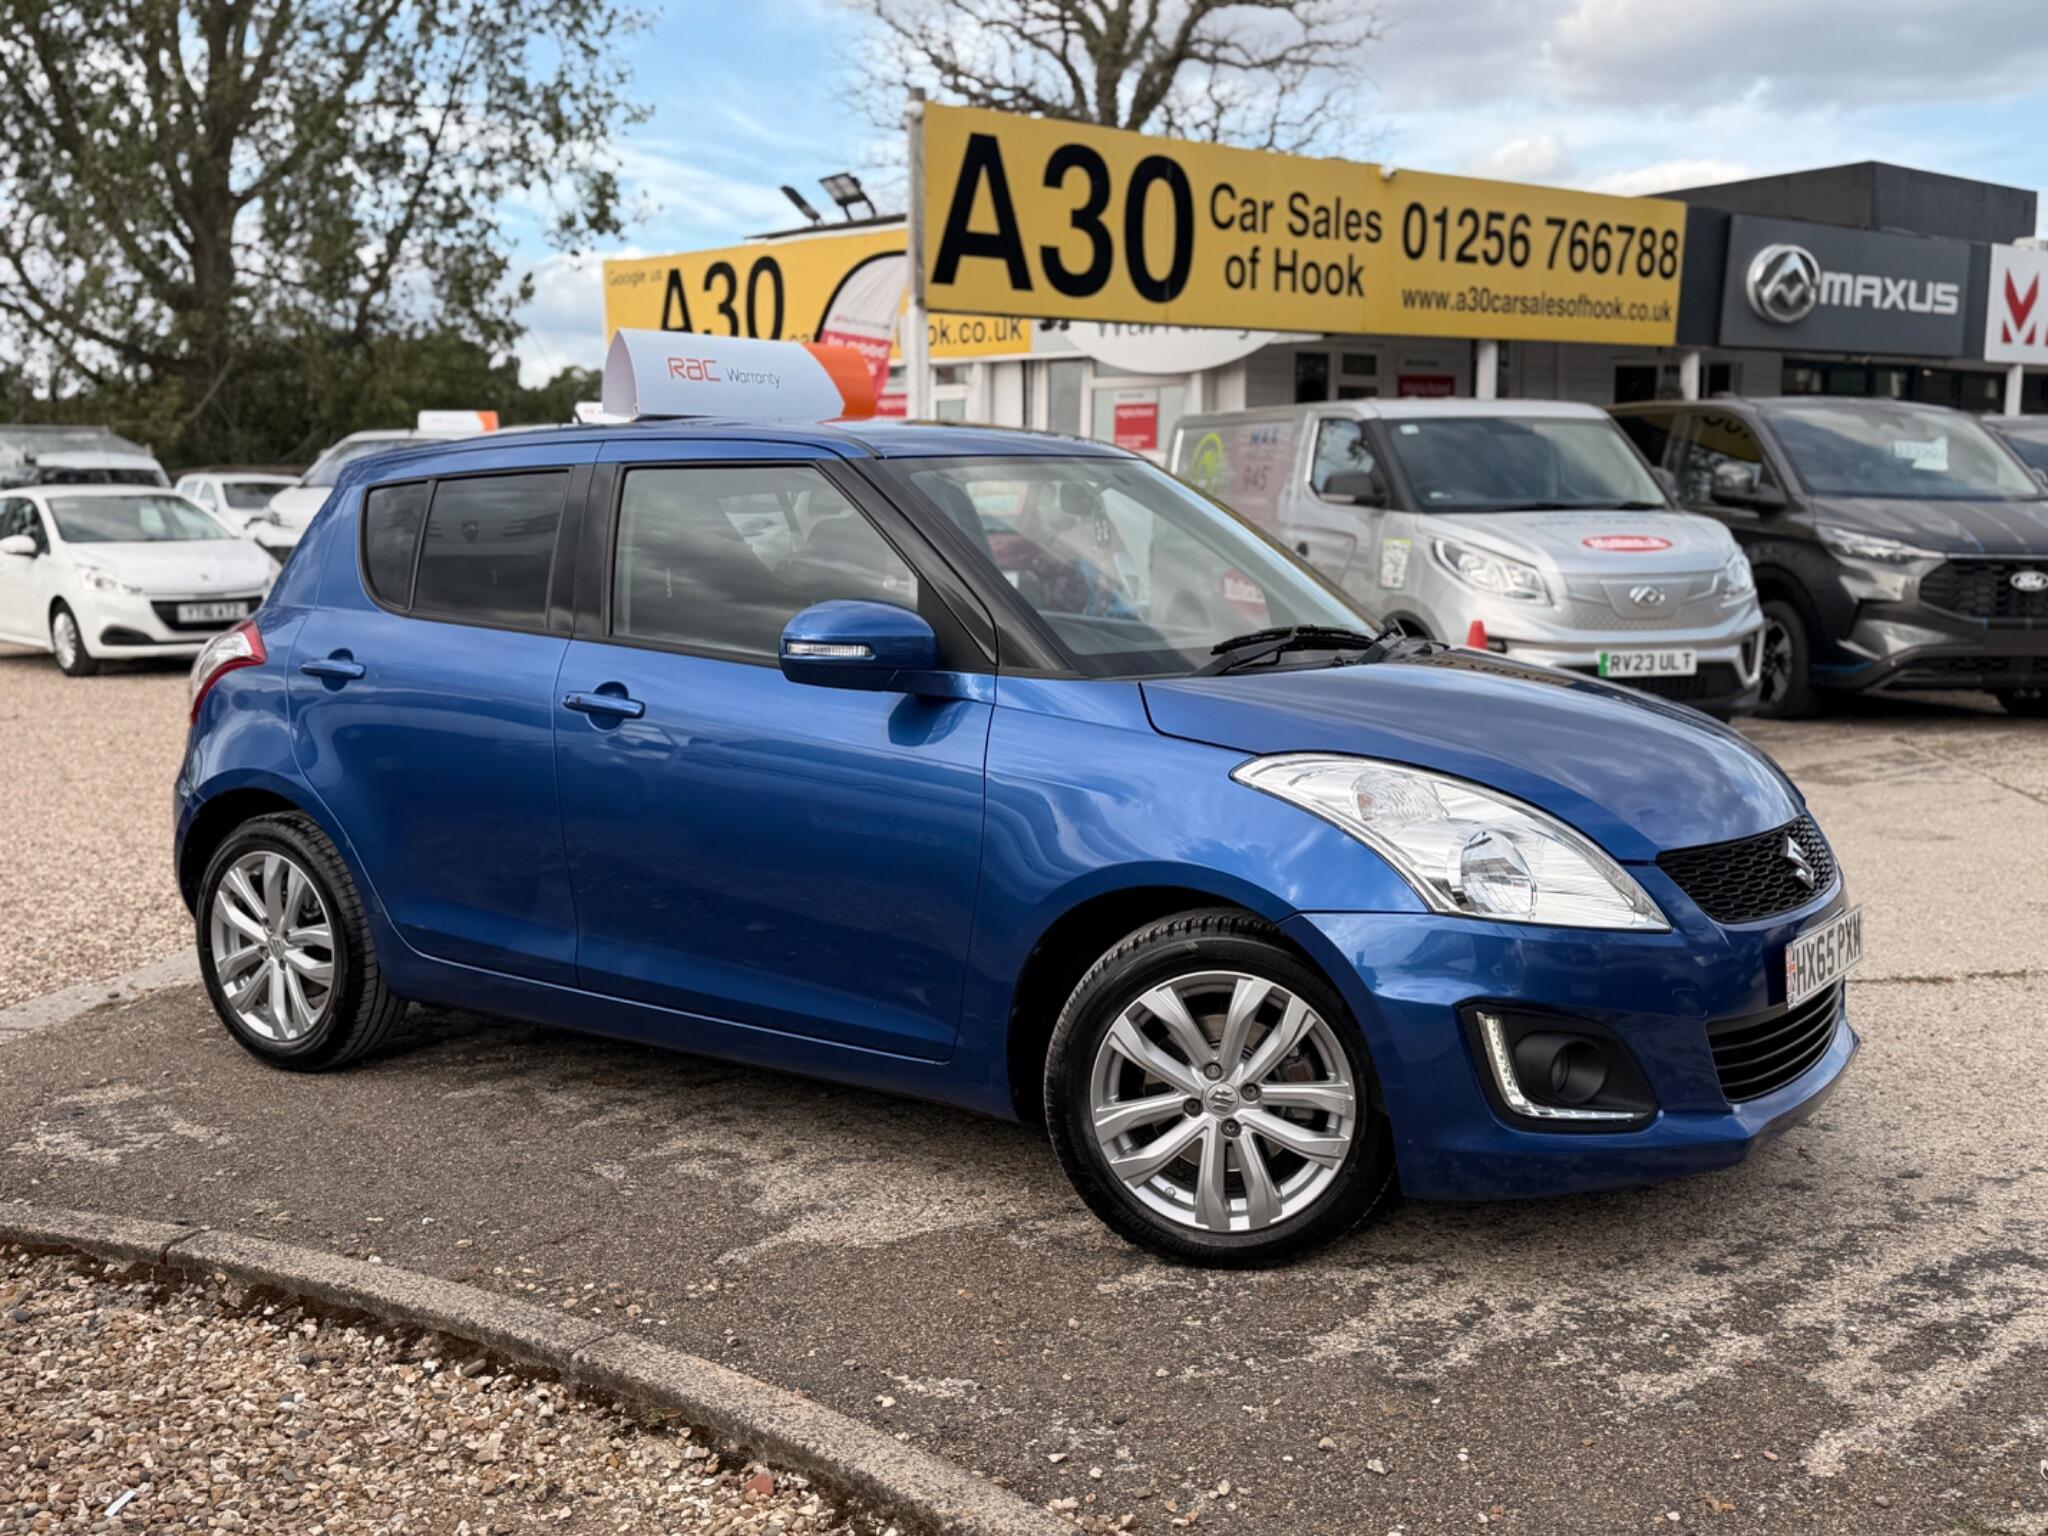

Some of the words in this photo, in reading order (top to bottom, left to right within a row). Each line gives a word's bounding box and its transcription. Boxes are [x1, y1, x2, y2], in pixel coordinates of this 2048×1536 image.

[931, 132, 1194, 303] A30
[1209, 182, 1274, 234] Car
[1287, 190, 1382, 243] Sales
[1402, 202, 1531, 268] 01256
[1545, 217, 1679, 280] 766788
[661, 256, 784, 341] A30
[1225, 245, 1260, 290] of
[1274, 247, 1364, 297] Hook
[1819, 271, 1960, 315] MAXUS
[1401, 286, 1673, 323] www.a30carsalesofhook.co.uk
[725, 367, 781, 389] Warranty
[1610, 654, 1655, 672] RV23
[1658, 652, 1692, 671] ULT
[1796, 927, 1835, 996] HX65
